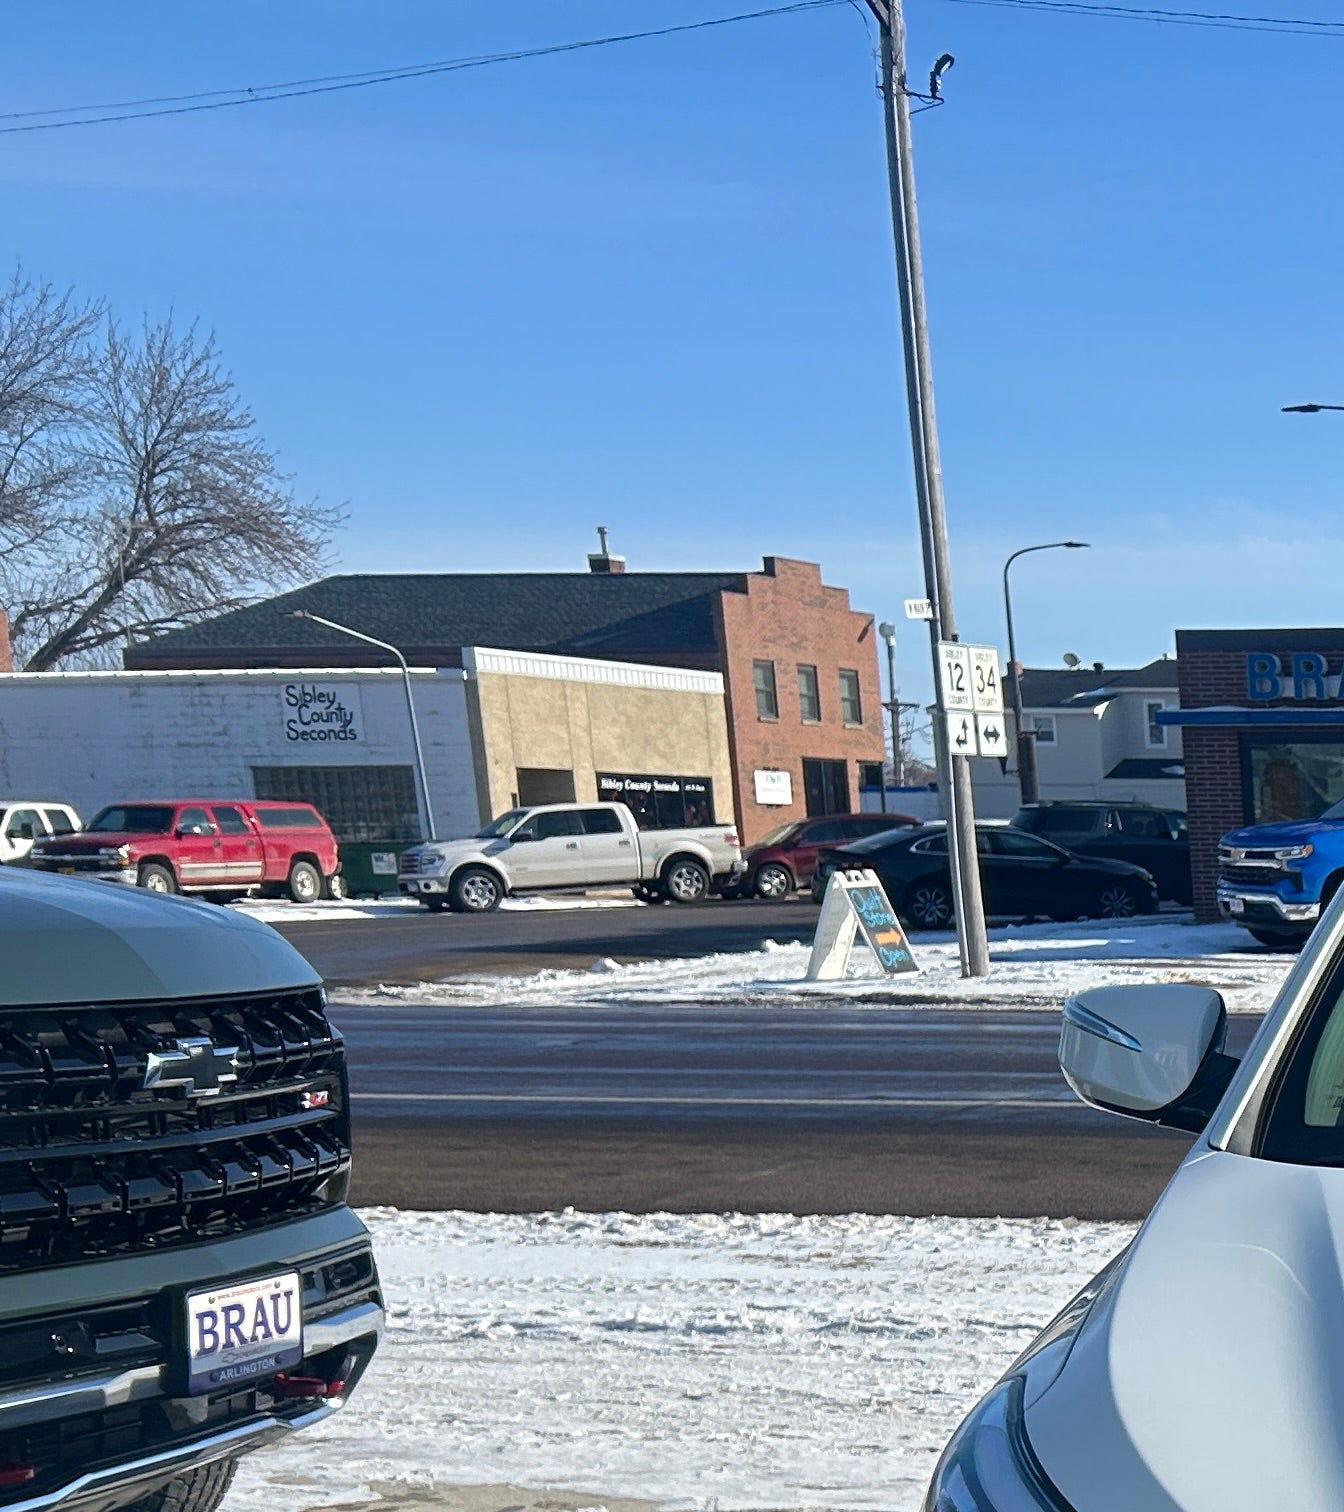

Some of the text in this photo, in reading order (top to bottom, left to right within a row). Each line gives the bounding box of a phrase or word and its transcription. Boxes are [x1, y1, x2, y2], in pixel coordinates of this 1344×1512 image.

[948, 662, 965, 692] 12
[976, 665, 996, 694] 34
[285, 684, 336, 710] Sibley
[298, 702, 353, 728] County
[286, 719, 357, 741] Seconds
[879, 947, 909, 968] Open
[195, 1290, 293, 1357] BRAU
[219, 1357, 275, 1381] ARLINGTON
